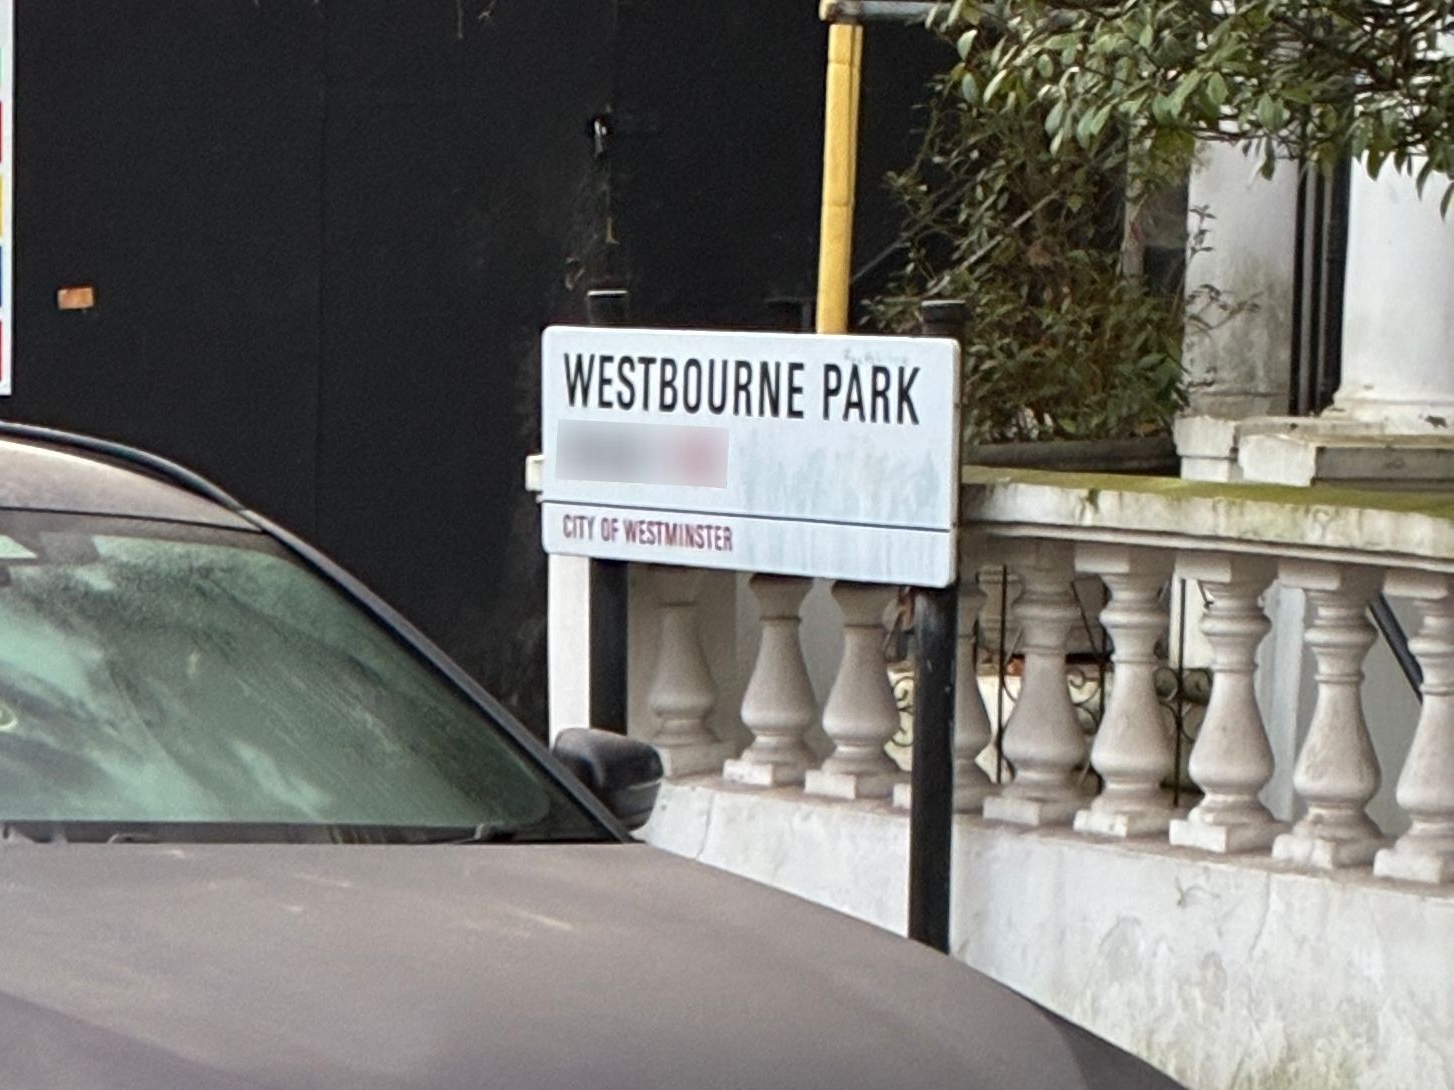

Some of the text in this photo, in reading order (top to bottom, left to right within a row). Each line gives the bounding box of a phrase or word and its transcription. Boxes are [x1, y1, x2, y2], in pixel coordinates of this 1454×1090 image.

[562, 352, 922, 426] WESTBOURNE PARK
[563, 514, 734, 553] CITY OF WESTMINSTER
